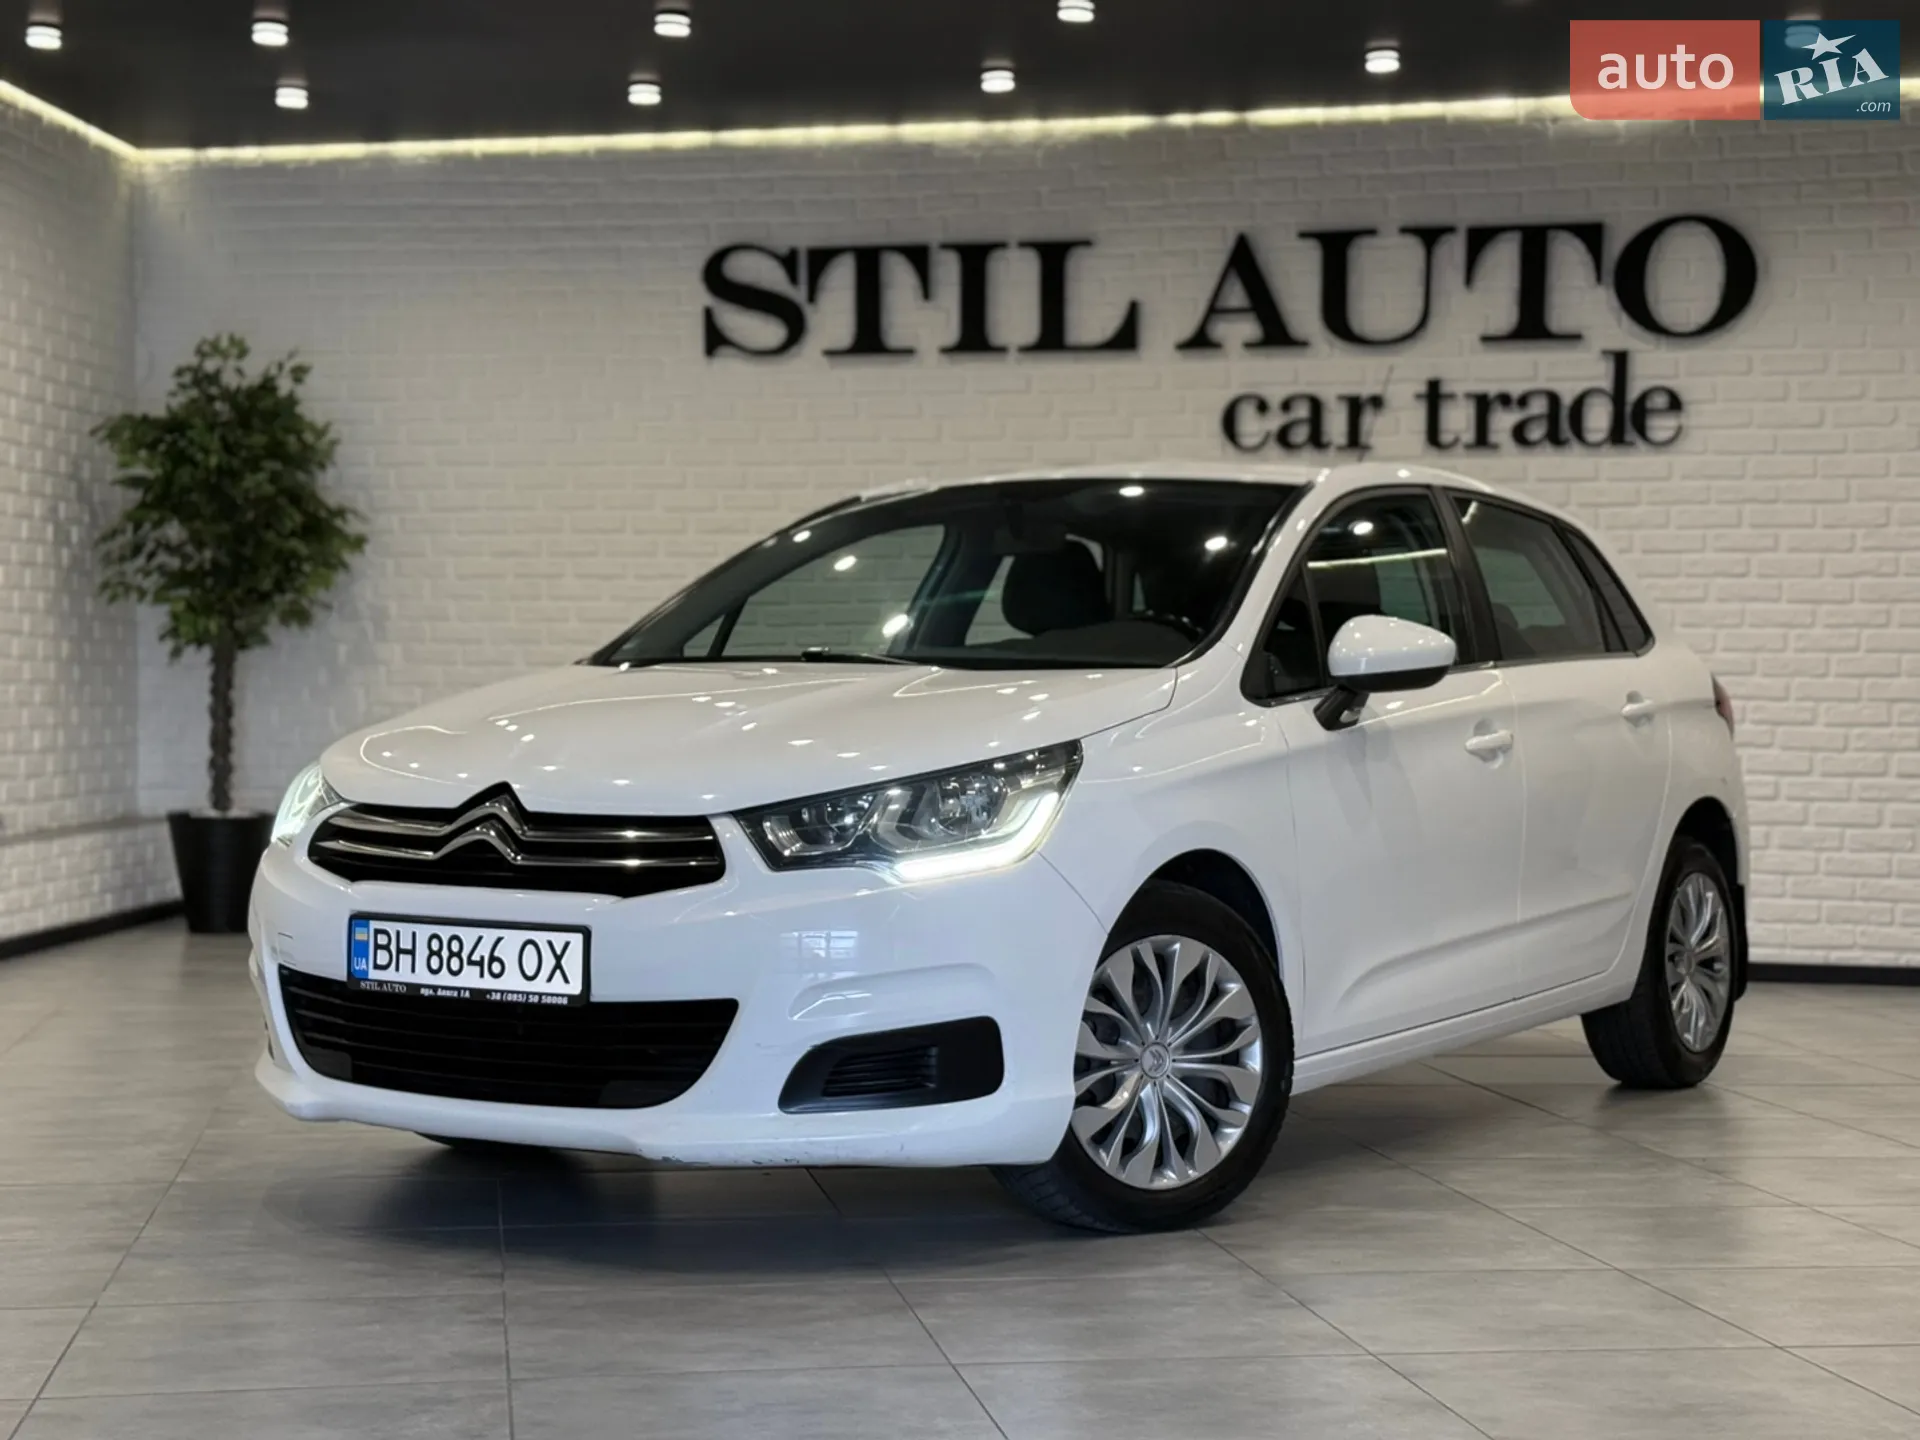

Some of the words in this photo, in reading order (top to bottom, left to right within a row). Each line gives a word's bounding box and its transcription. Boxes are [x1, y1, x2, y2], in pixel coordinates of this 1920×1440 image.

[702, 239, 1140, 359] STIL
[1176, 214, 1758, 352] AUTO
[1221, 386, 1384, 452] car
[1413, 350, 1687, 452] trade
[353, 957, 368, 970] UA
[372, 928, 417, 974] BH
[426, 932, 507, 979] 8846
[518, 938, 572, 984] OX
[360, 981, 381, 992] STIL
[381, 983, 407, 993] AUTO
